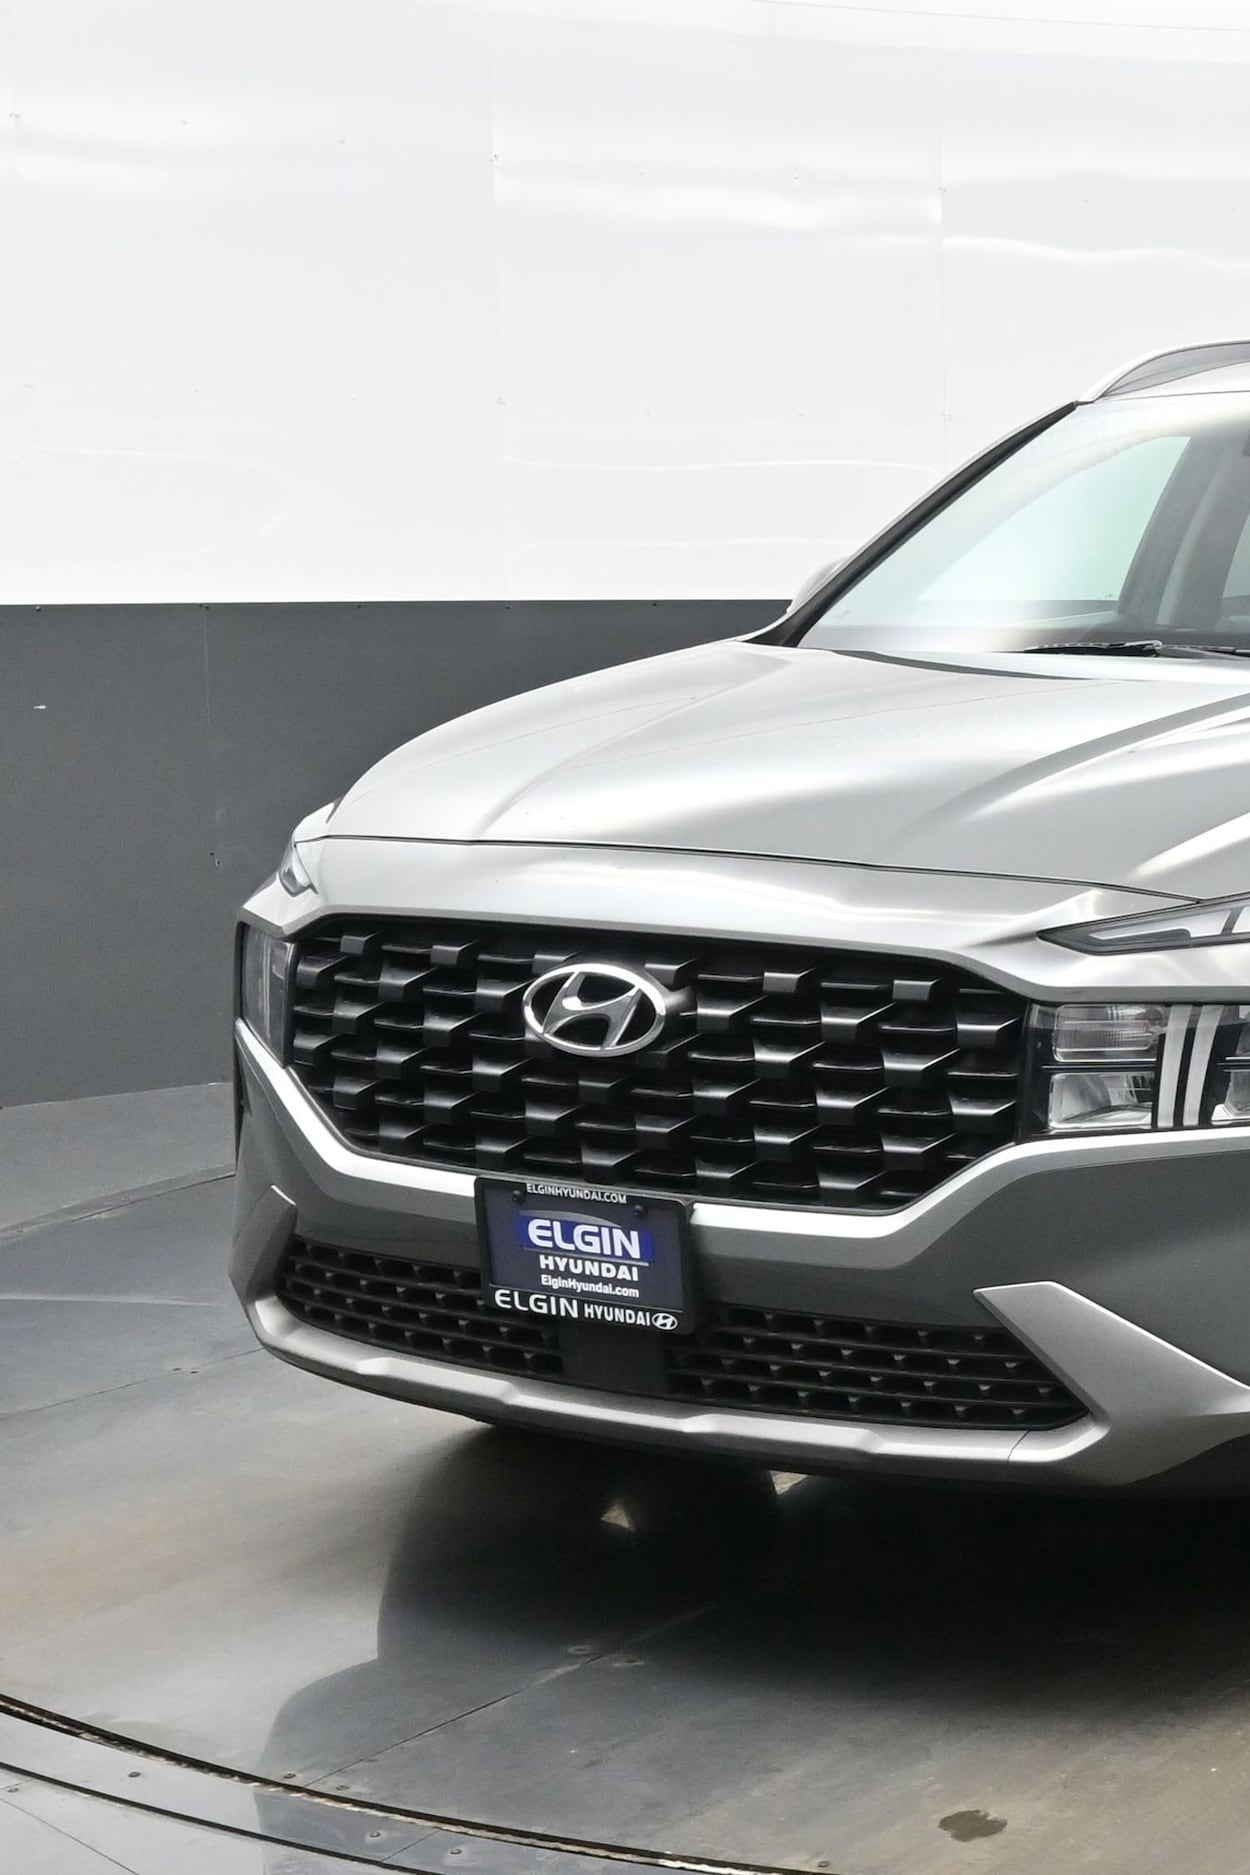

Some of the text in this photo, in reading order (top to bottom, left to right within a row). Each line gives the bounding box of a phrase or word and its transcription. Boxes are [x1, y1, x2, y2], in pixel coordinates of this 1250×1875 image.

[526, 1183, 627, 1204] ELGINHYUNDAI.COM
[527, 1219, 641, 1259] ELGIN
[539, 1255, 639, 1282] HYUNDAI
[541, 1274, 640, 1298] ElginHyundai.com
[494, 1289, 650, 1327] ELGIN HYUNDAI
